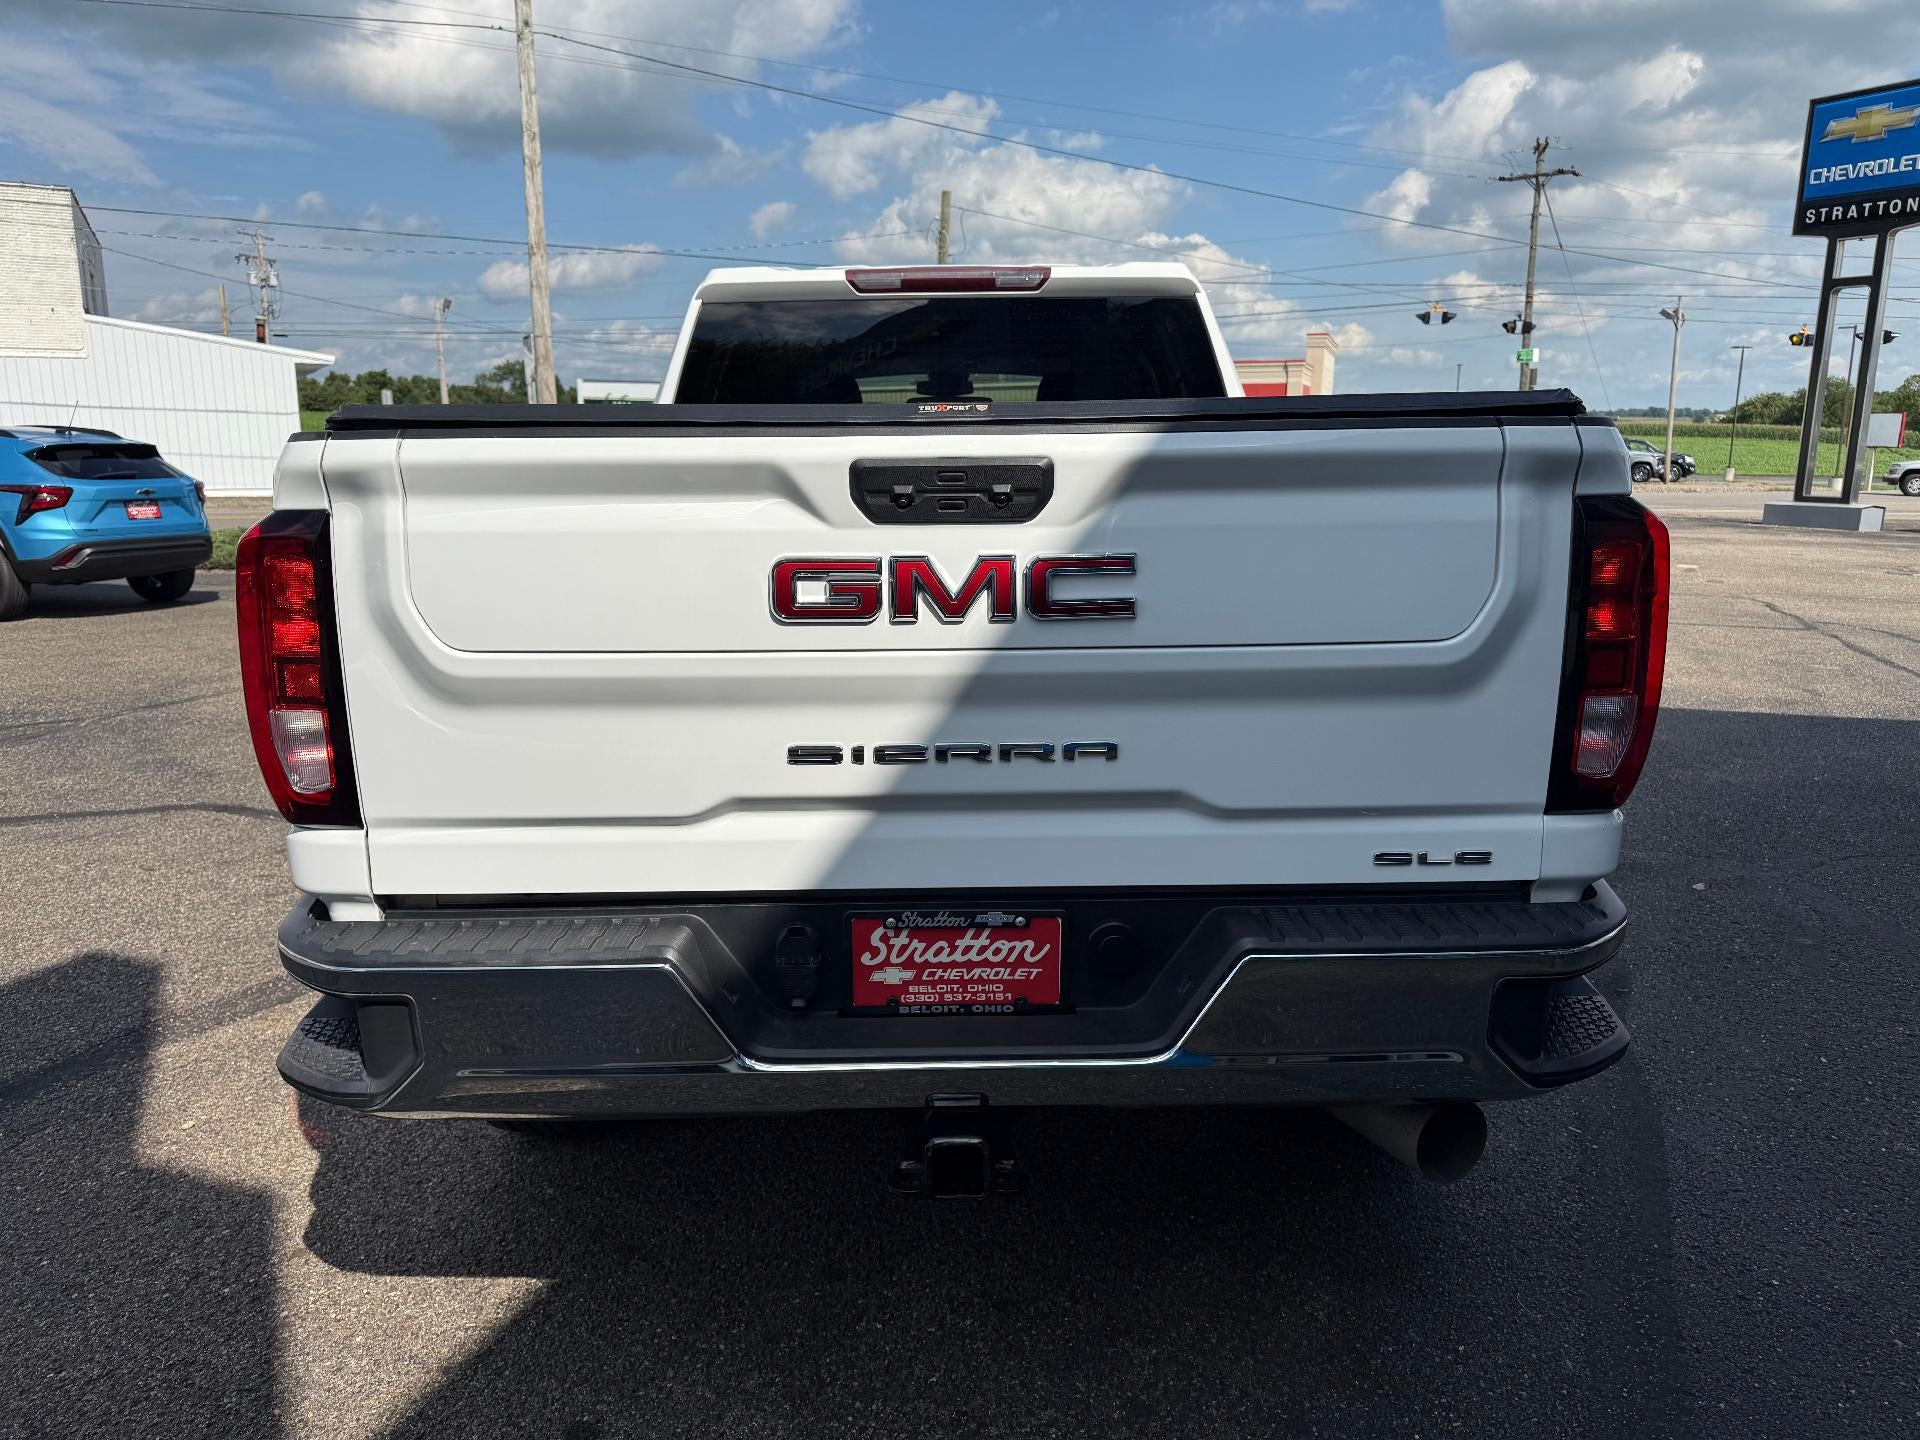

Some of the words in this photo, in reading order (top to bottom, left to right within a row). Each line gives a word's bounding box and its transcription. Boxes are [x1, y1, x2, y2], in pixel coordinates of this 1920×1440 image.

[1805, 198, 1919, 224] STRATTON
[769, 552, 1137, 625] GMC
[786, 741, 1118, 766] SIERRA
[1374, 850, 1493, 865] SLE
[899, 911, 971, 927] Stratton
[860, 927, 1051, 966] Stratton
[921, 968, 1043, 980] CHEVROLET
[908, 985, 964, 993] BELOIT,
[967, 984, 1004, 992] OHIO
[900, 994, 939, 1003] (330)
[943, 993, 1012, 1001] 537-3151
[898, 1005, 965, 1013] BELOIT,
[971, 1005, 1015, 1013] OHIO
